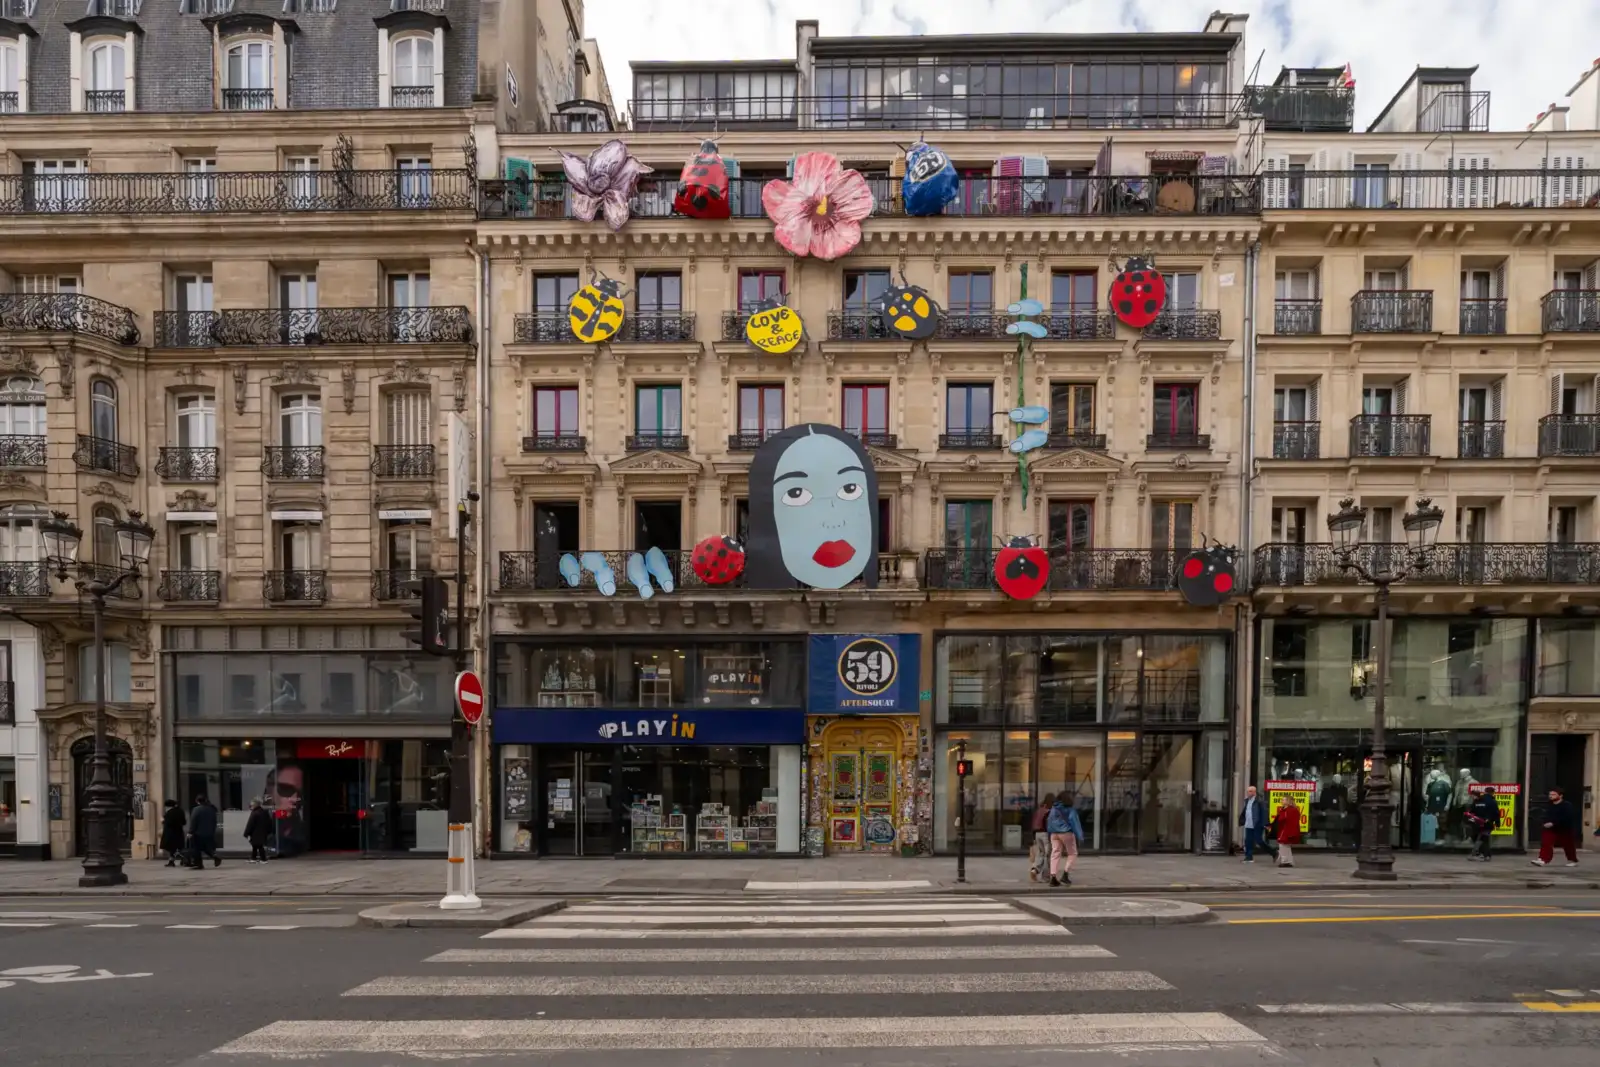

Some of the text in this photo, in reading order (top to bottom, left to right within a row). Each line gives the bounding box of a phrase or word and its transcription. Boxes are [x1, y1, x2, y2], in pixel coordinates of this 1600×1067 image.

[751, 309, 789, 328] LOVE
[771, 324, 783, 335] &
[757, 330, 799, 348] PEACE
[845, 650, 892, 683] 59
[840, 699, 895, 707] AFTERSQUAT
[325, 741, 353, 757] Ray-Ban
[1500, 785, 1519, 793] JOURS
